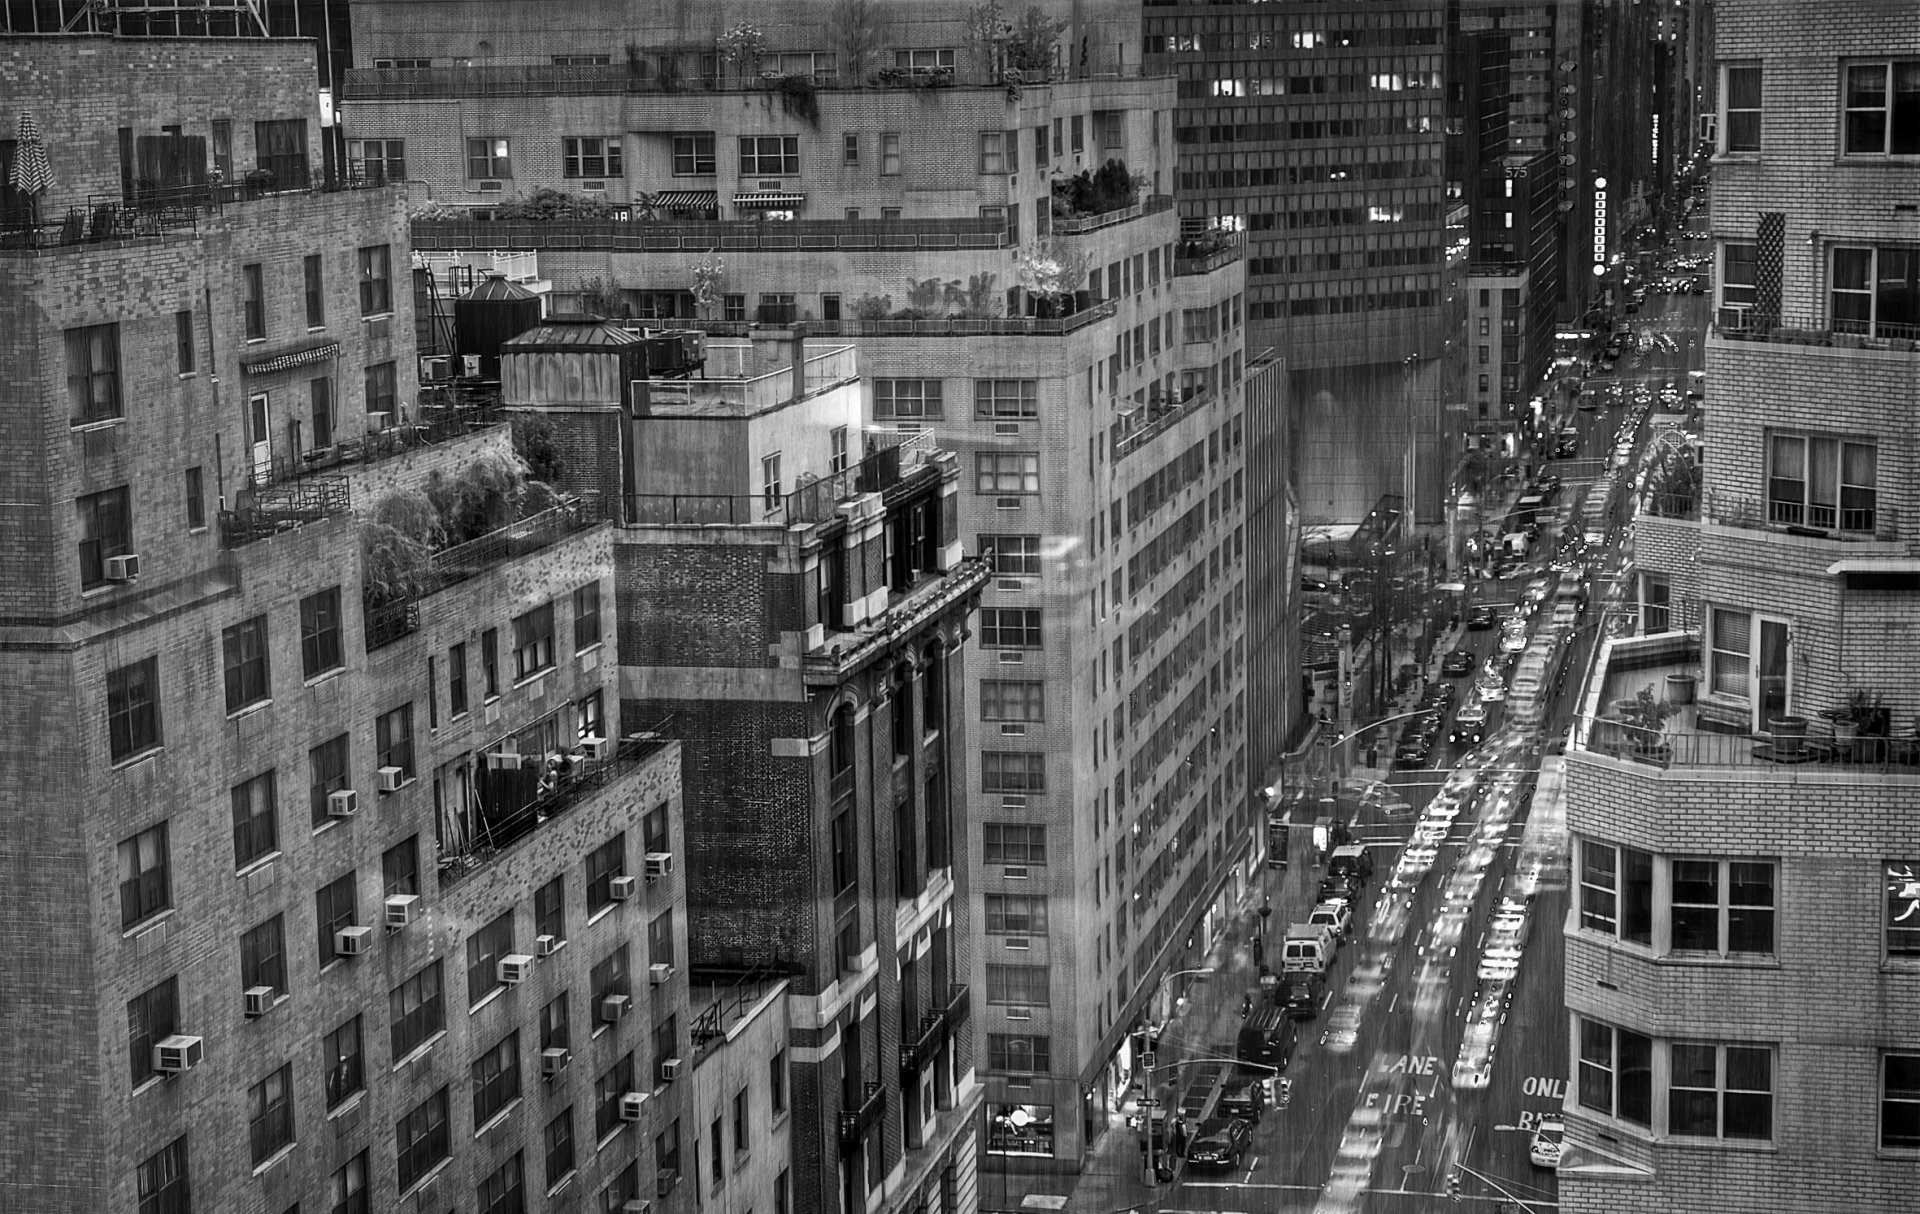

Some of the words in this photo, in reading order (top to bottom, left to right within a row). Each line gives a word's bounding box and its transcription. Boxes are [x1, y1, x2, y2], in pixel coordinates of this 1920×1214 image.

[1504, 166, 1528, 179] 575
[1377, 1053, 1438, 1076] LANE
[1523, 1076, 1569, 1099] ONL
[1365, 1093, 1427, 1116] FIRE
